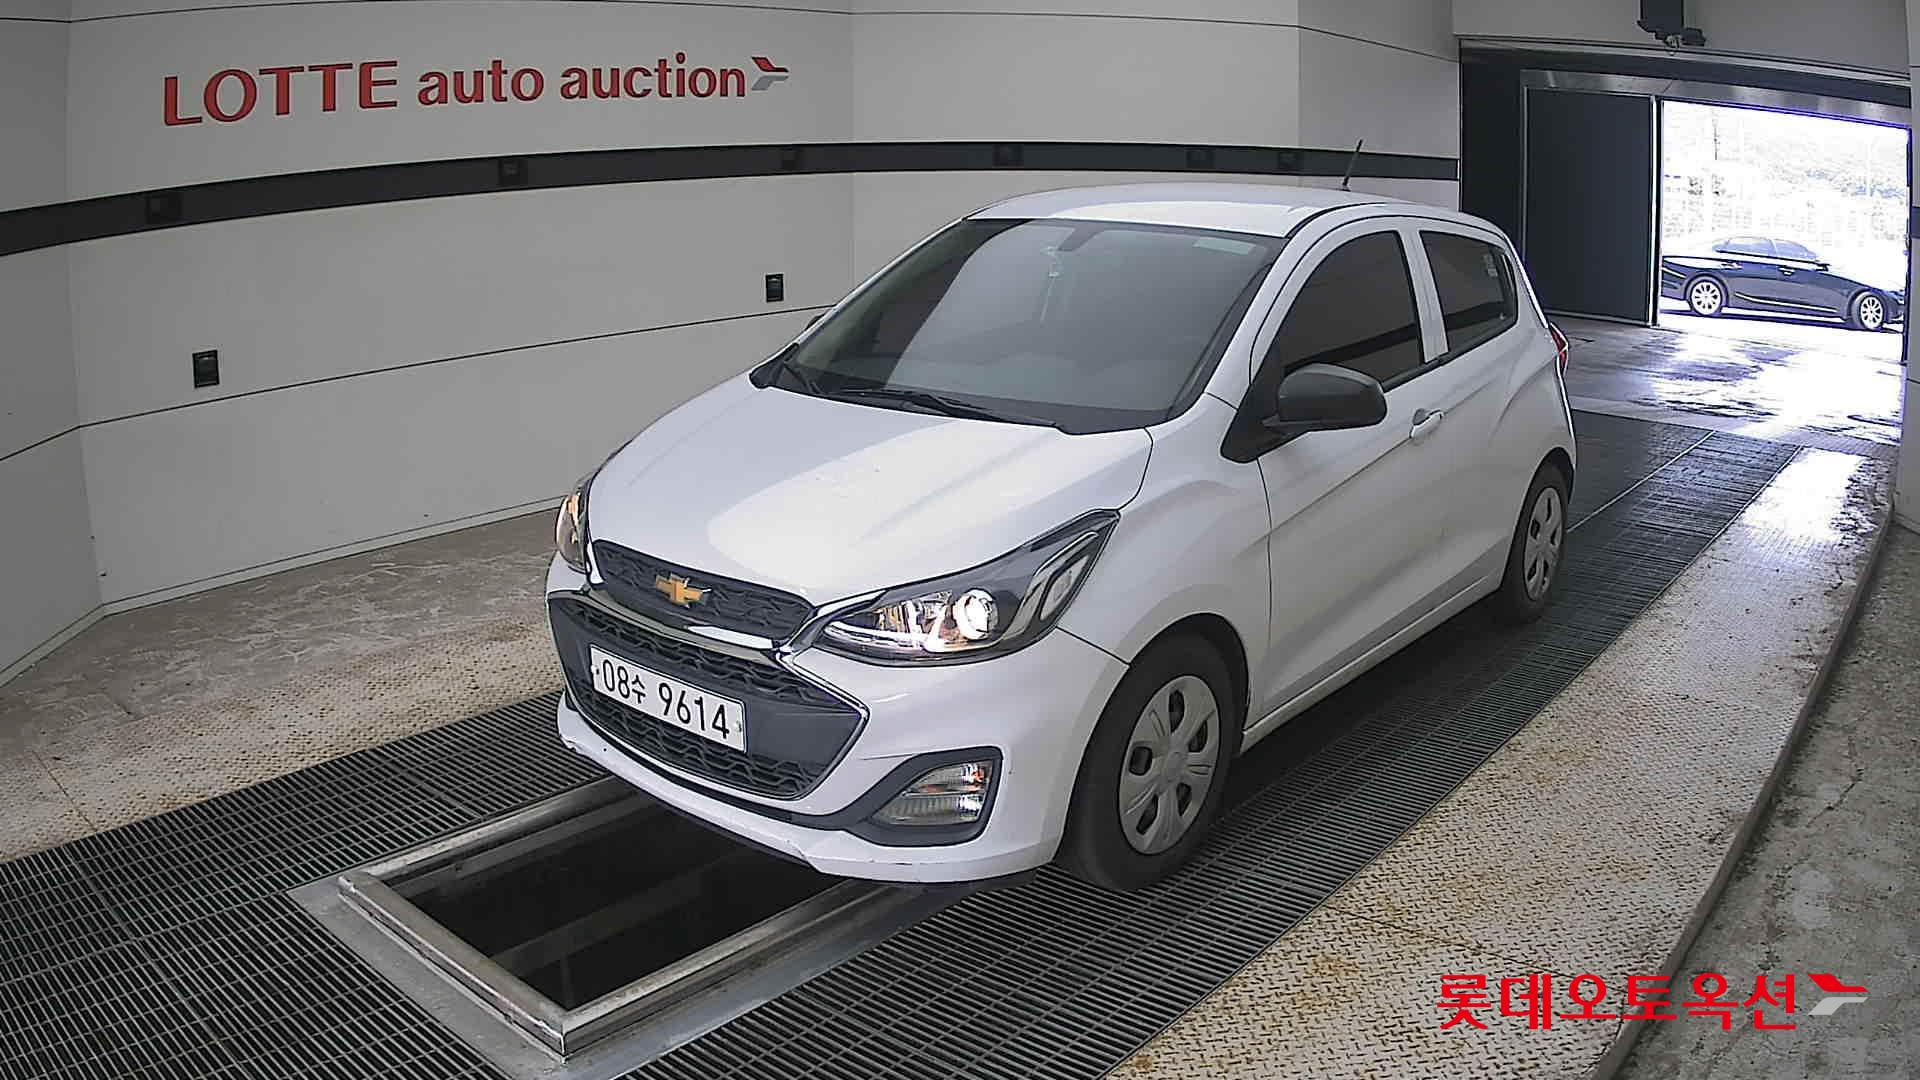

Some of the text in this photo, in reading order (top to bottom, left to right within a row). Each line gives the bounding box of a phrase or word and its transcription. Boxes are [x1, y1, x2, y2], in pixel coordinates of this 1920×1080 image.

[163, 52, 746, 126] LOTTE auto auction
[602, 659, 730, 739] 08수 9614
